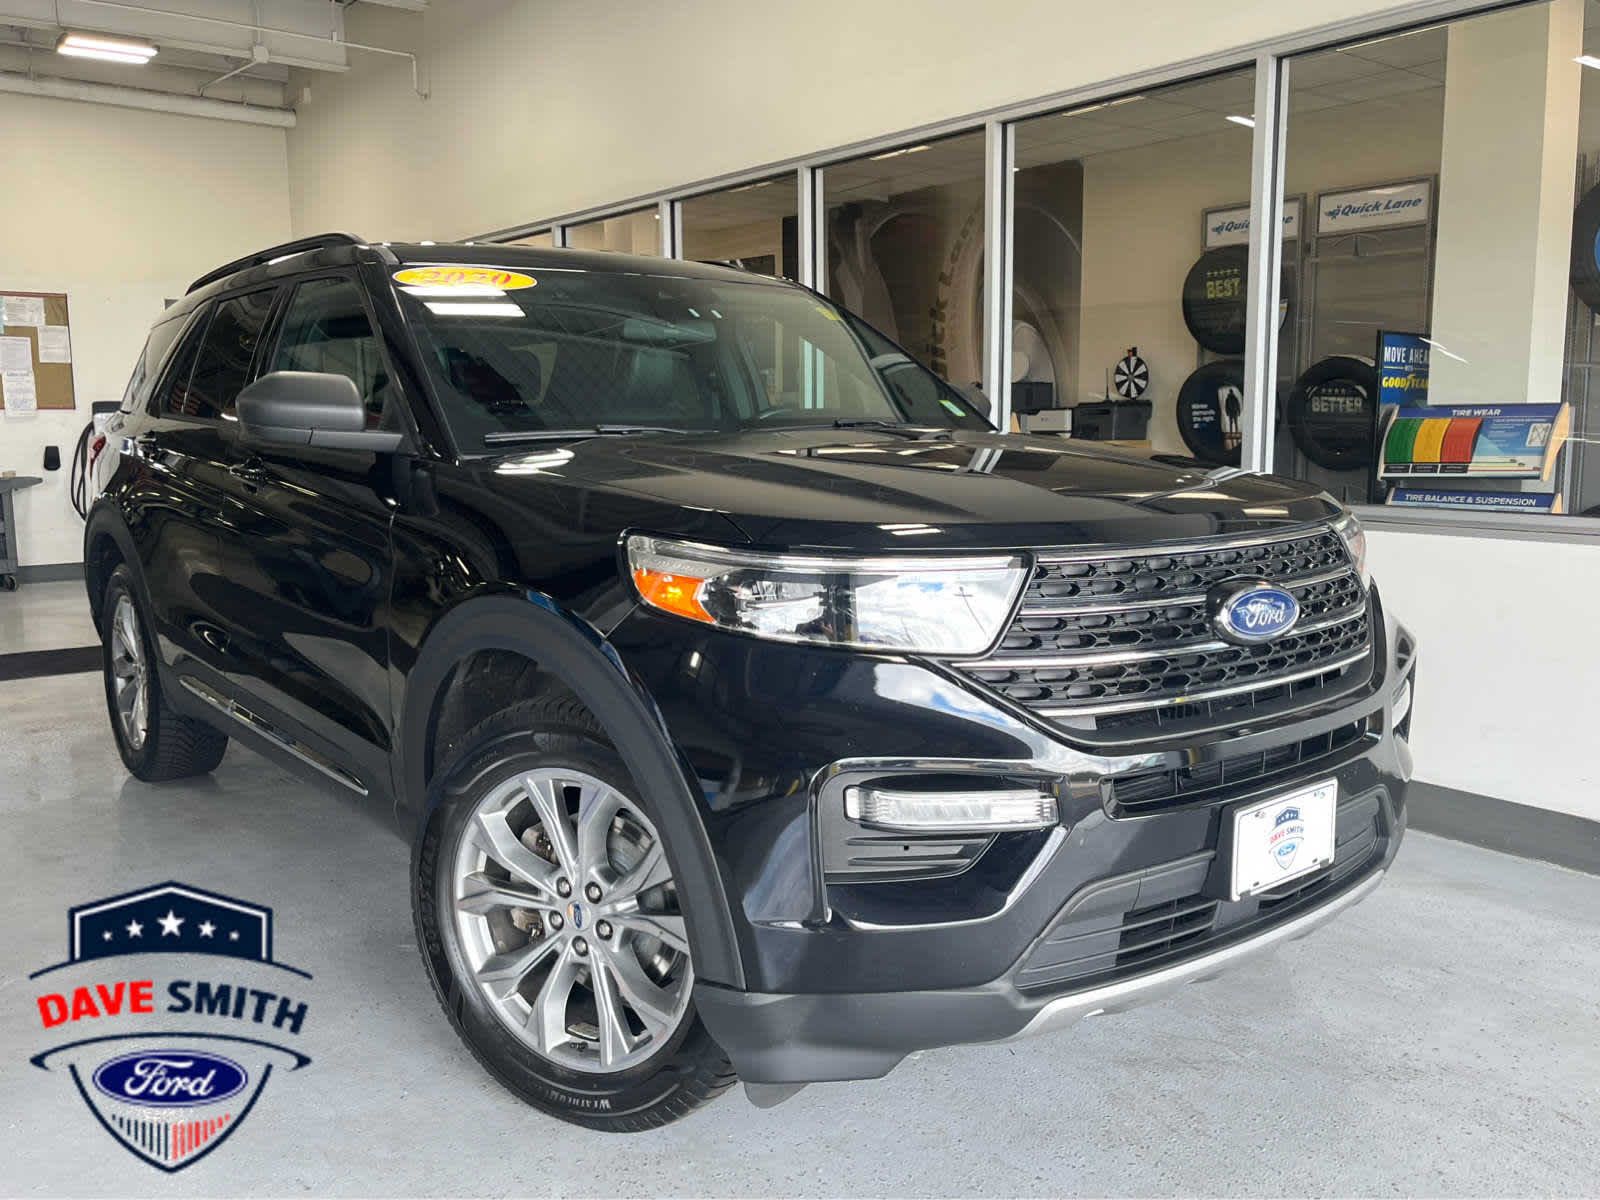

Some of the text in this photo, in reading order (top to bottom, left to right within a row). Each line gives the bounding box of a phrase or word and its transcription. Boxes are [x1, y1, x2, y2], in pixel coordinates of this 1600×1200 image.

[1341, 200, 1380, 217] Quick
[1384, 196, 1422, 211] Lane
[1224, 220, 1251, 233] Quic
[1206, 279, 1240, 299] BEST
[1384, 346, 1429, 364] MOVE AHEA
[1311, 397, 1362, 413] BETTER
[1425, 495, 1467, 504] BALANCE
[1475, 496, 1536, 506] SUSPENSION
[1236, 598, 1285, 628] Ford
